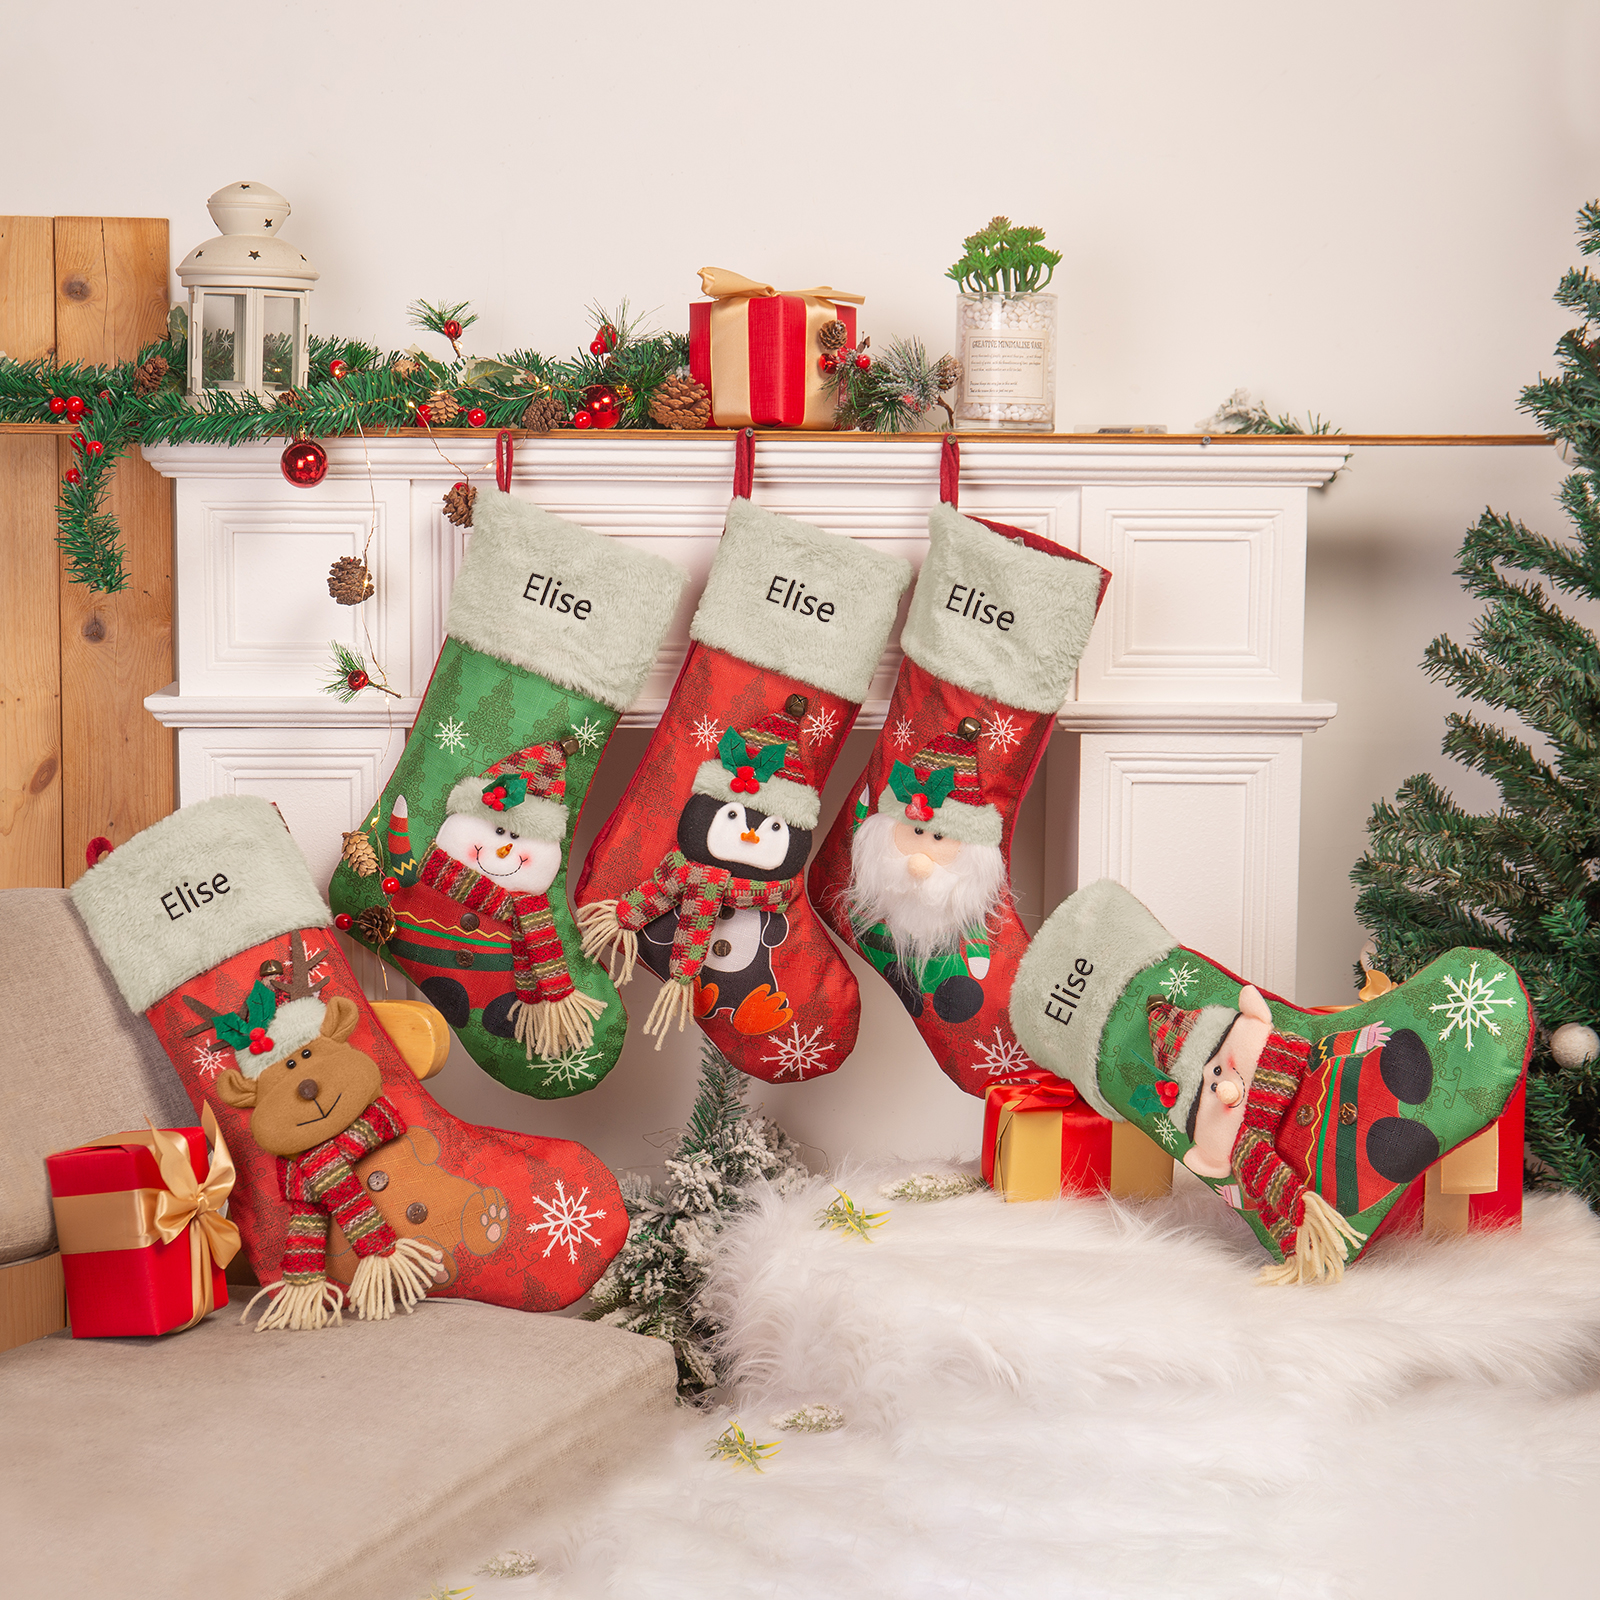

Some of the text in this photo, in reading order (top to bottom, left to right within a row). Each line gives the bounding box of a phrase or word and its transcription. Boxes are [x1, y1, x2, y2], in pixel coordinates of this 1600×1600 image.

[523, 573, 592, 620] Elise
[766, 576, 835, 622] Elise
[946, 584, 1015, 631] Elise
[161, 873, 231, 920] Elise
[1045, 958, 1094, 1025] Elise
